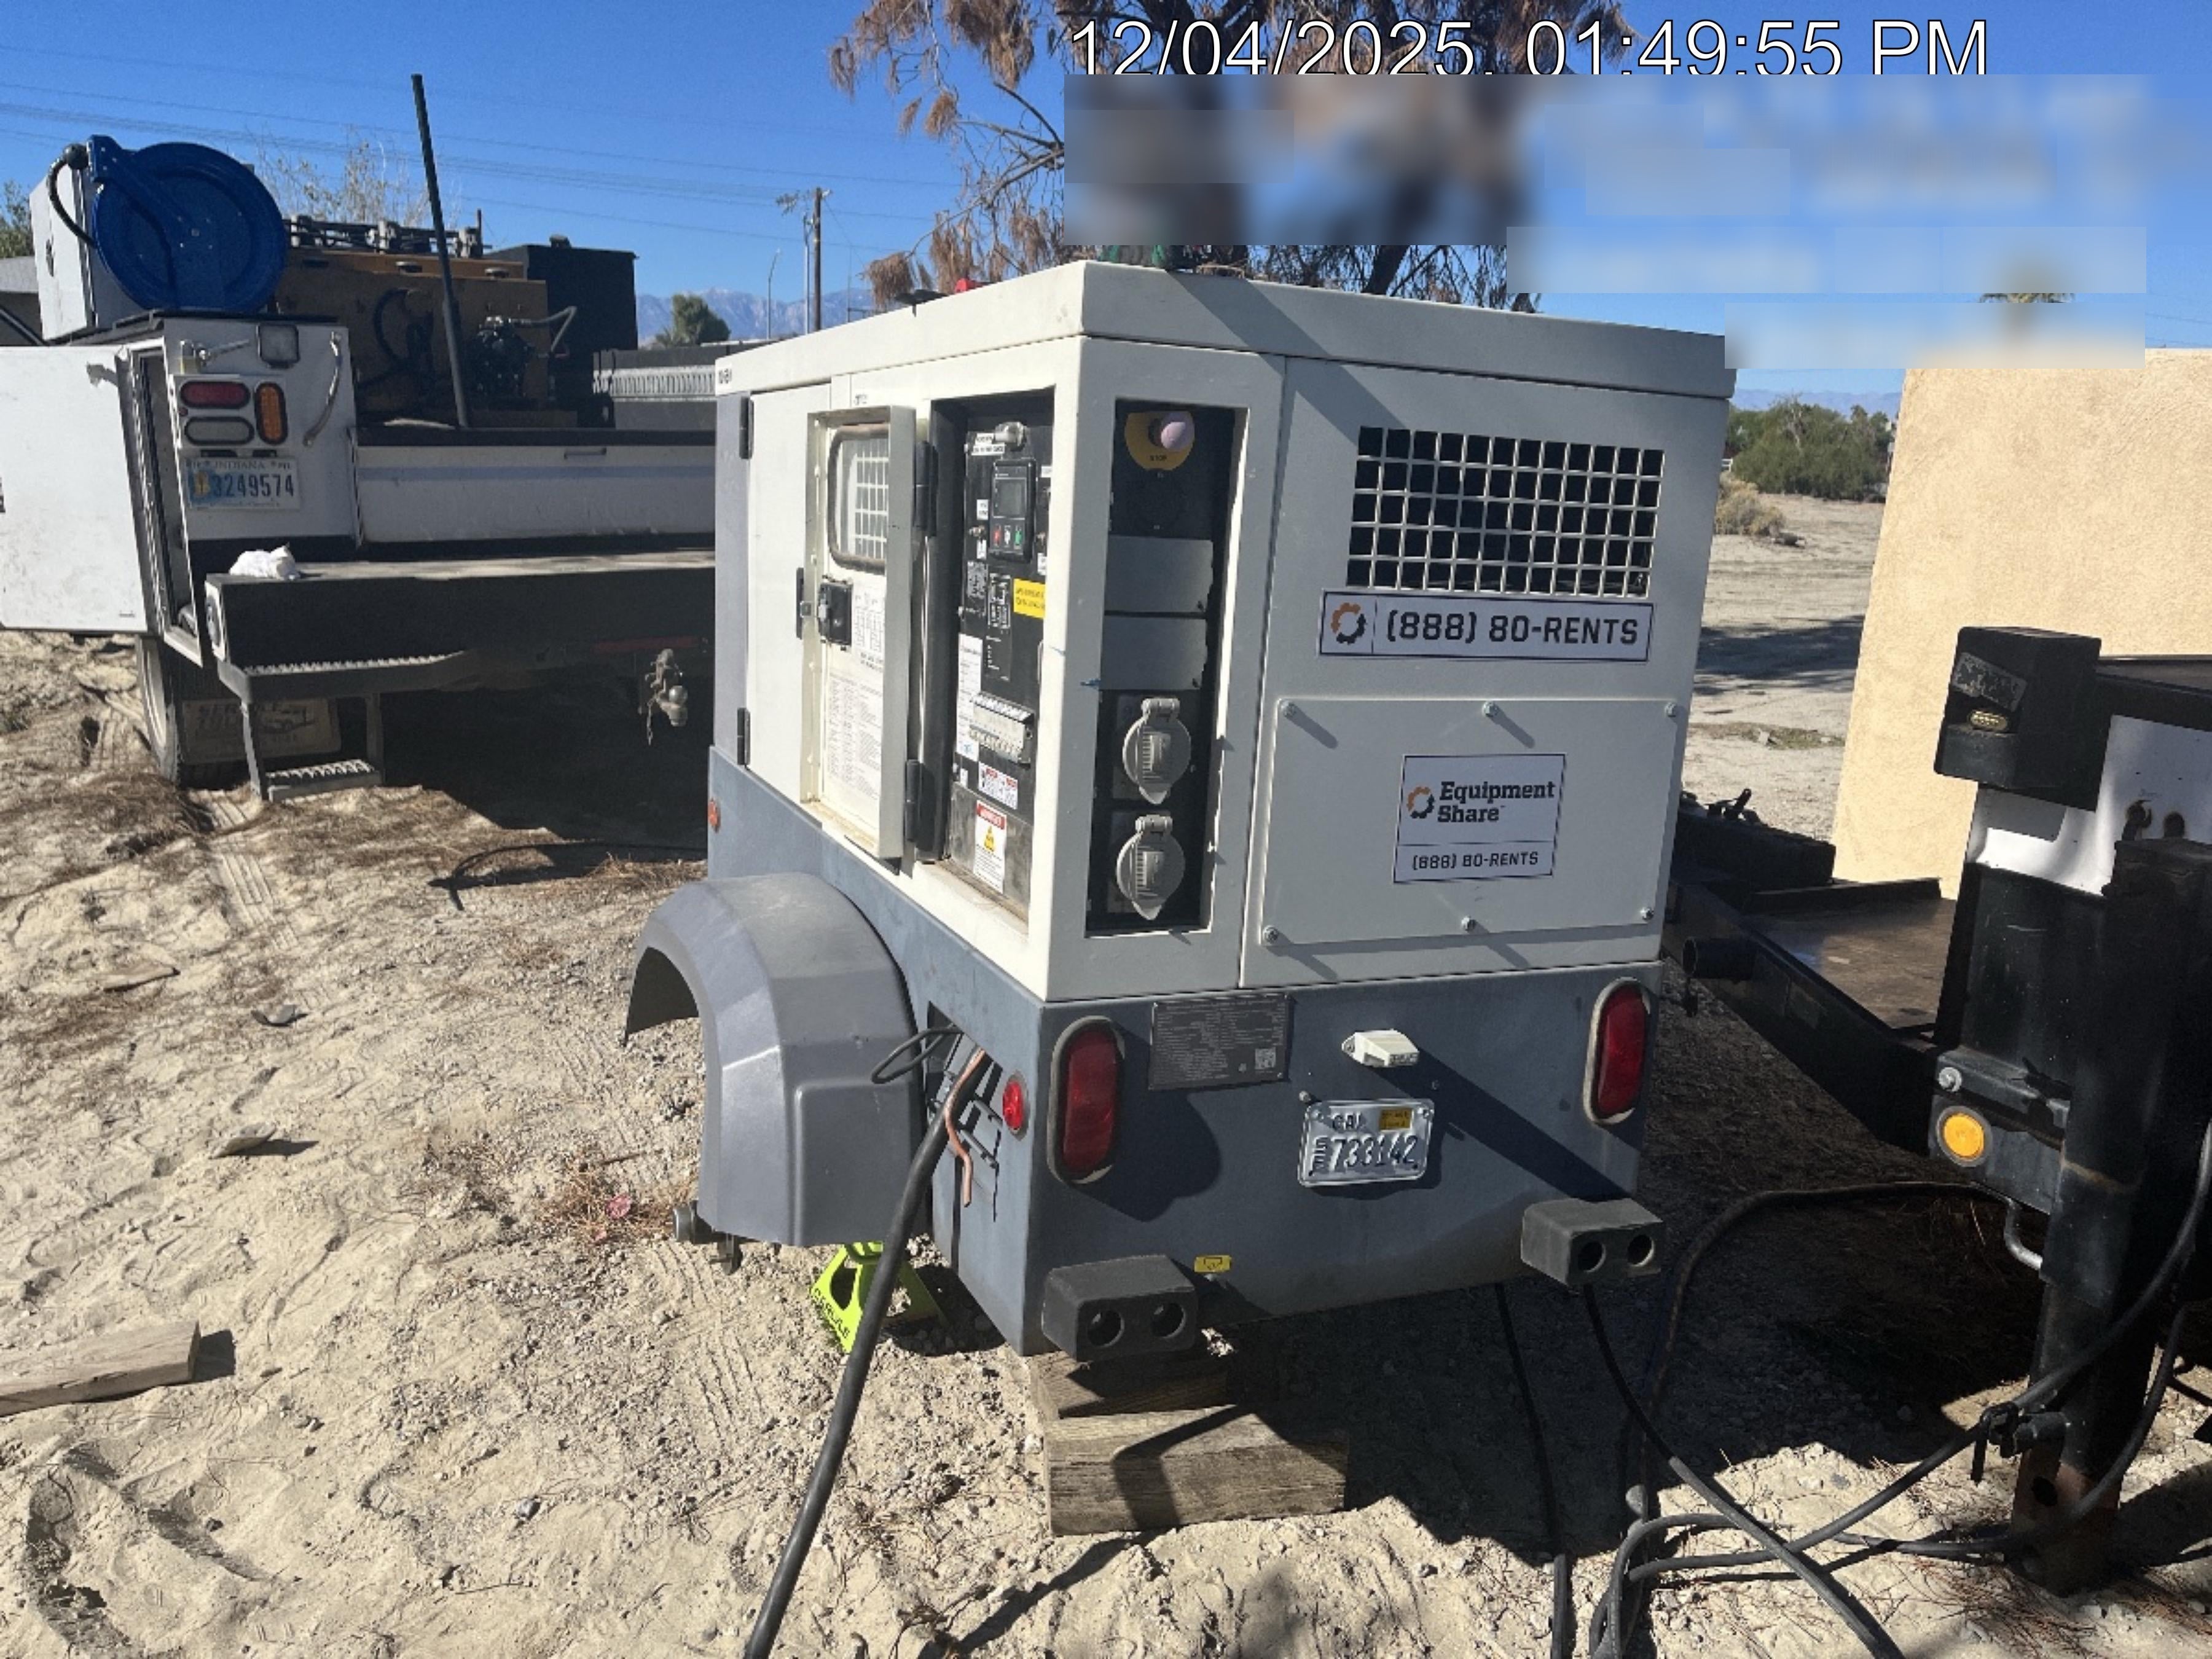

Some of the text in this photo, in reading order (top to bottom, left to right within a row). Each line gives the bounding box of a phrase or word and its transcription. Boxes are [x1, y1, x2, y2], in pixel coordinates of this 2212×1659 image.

[216, 461, 265, 469] INDIANA
[212, 473, 294, 498] 3249574
[1387, 610, 1639, 645] (888) 80-RENTS
[1439, 781, 1556, 804] Equipment
[1437, 805, 1500, 823] Share
[1413, 852, 1539, 871] (888) 80-RENTS
